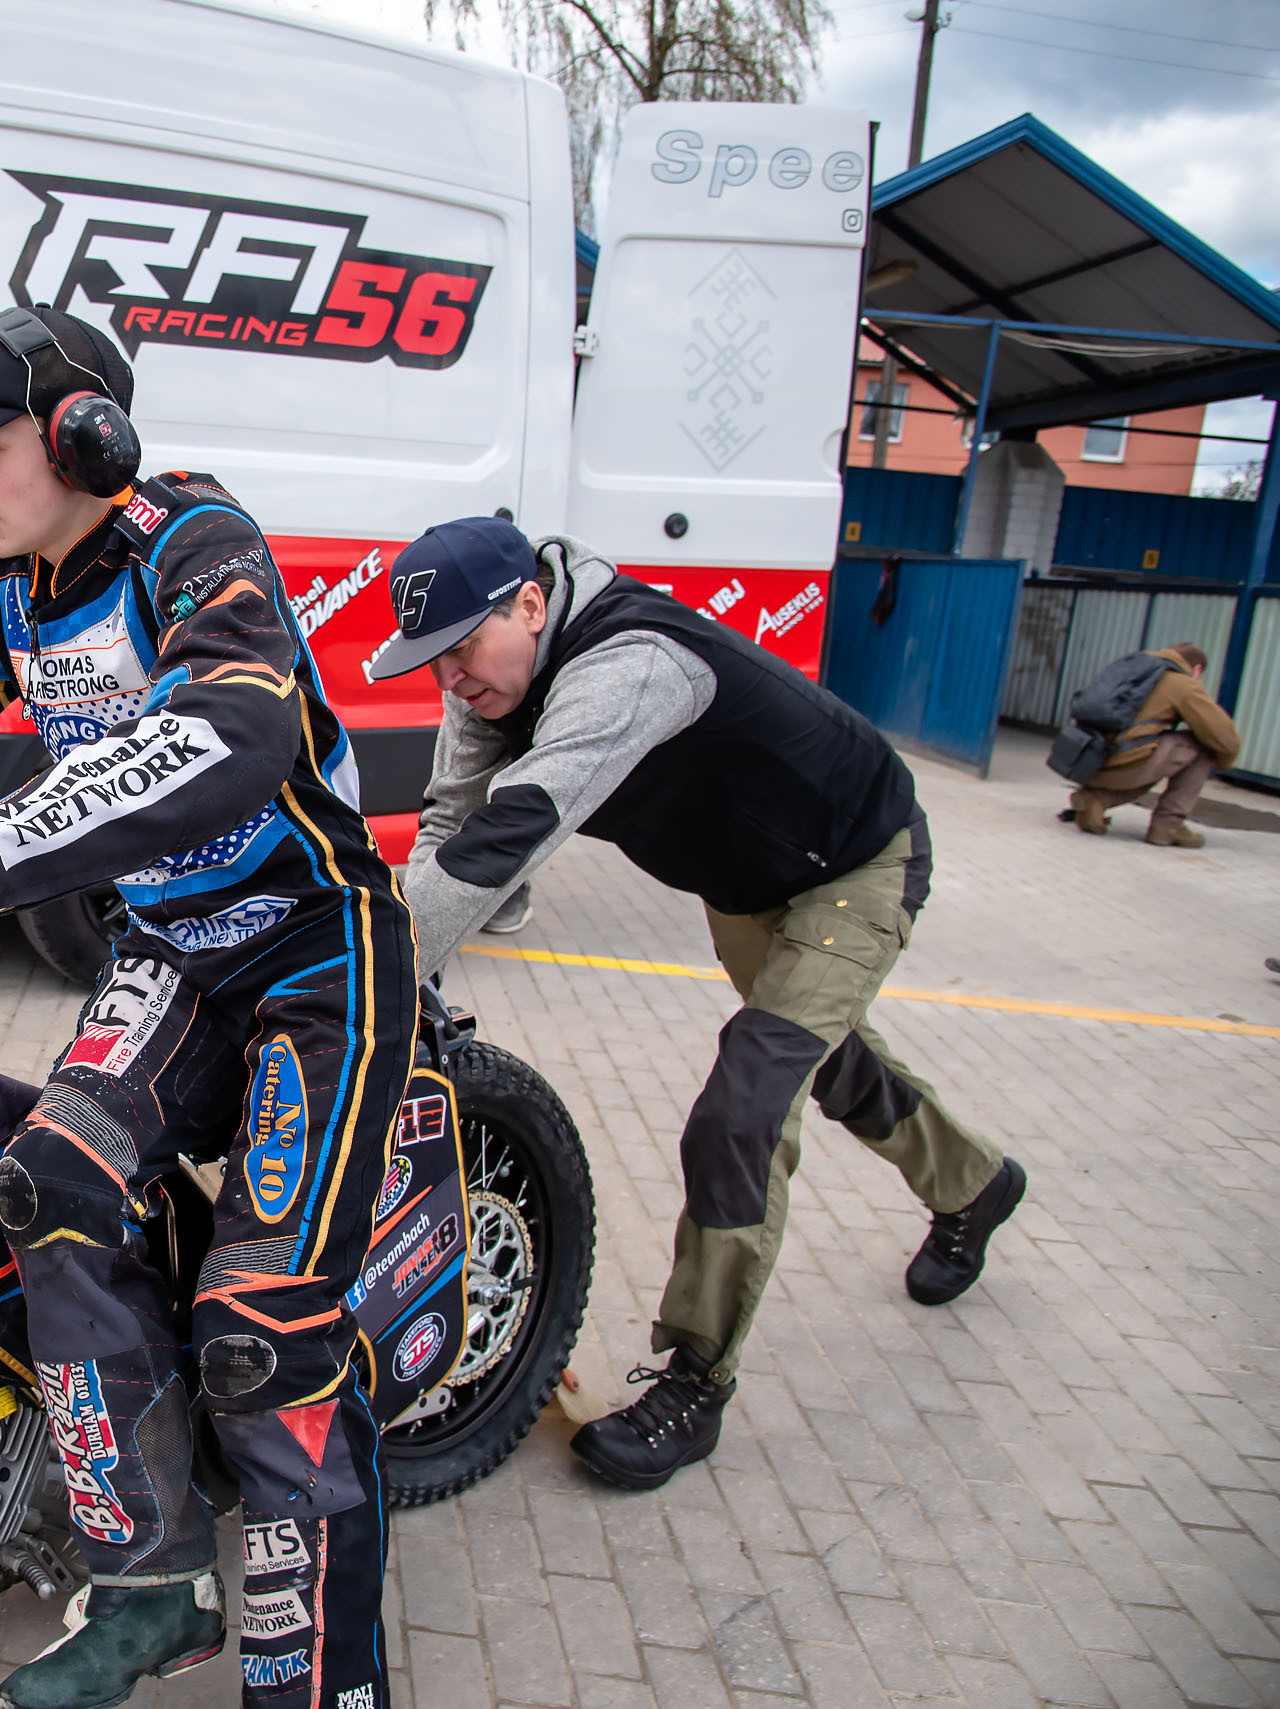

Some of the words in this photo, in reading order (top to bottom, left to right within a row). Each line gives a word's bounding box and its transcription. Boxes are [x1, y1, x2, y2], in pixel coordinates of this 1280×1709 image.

[651, 130, 864, 198] Spee
[123, 306, 309, 346] RACING
[314, 260, 480, 356] 56
[297, 547, 384, 640] DVANCE
[708, 578, 746, 615] VBJ
[42, 656, 95, 678] OMAS
[6, 734, 210, 847] NETWORK
[106, 1047, 132, 1072] Fire
[123, 1011, 160, 1047] Training
[255, 1044, 287, 1147] Catering
[258, 1152, 288, 1202] 10
[365, 1213, 430, 1290] @teambach
[438, 1213, 459, 1253] 8
[392, 1236, 432, 1291] JONAS
[402, 1325, 435, 1369] STS
[78, 1403, 108, 1460] DURHAM
[244, 1523, 300, 1561] FTS
[268, 1556, 305, 1570] Services
[275, 1649, 312, 1683] TK
[337, 1683, 373, 1706] MALI
